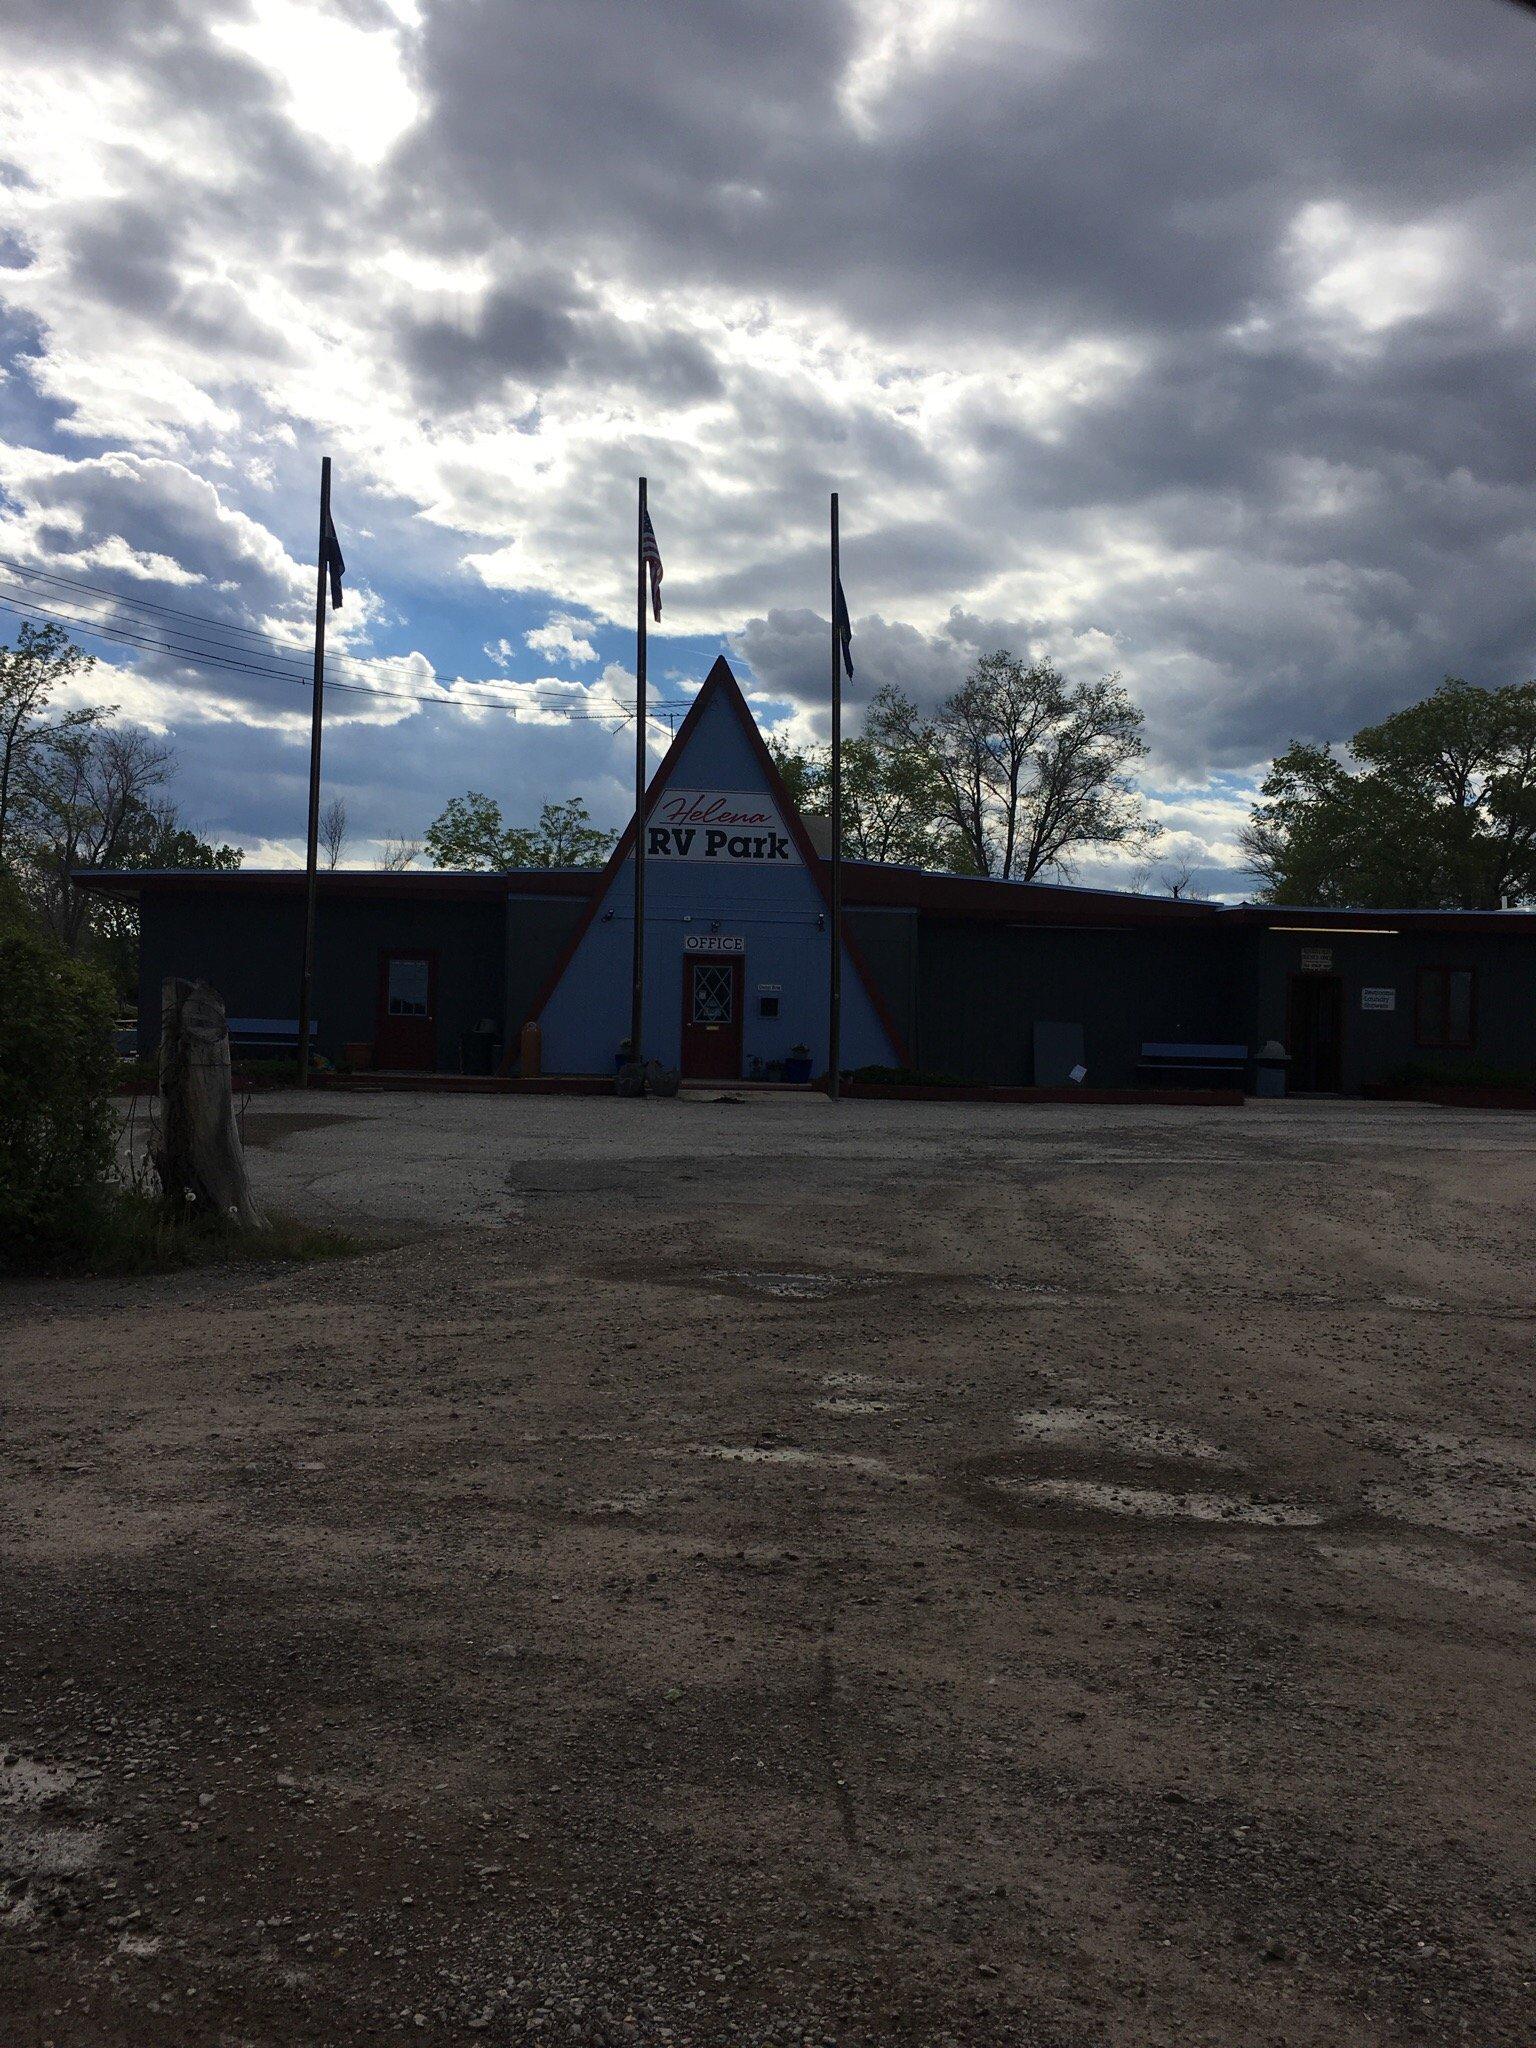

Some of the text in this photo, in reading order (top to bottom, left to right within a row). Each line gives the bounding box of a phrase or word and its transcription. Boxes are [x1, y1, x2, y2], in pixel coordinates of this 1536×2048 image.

[663, 794, 771, 825] Helena
[648, 828, 789, 859] RV Park
[687, 937, 742, 949] OFFICE
